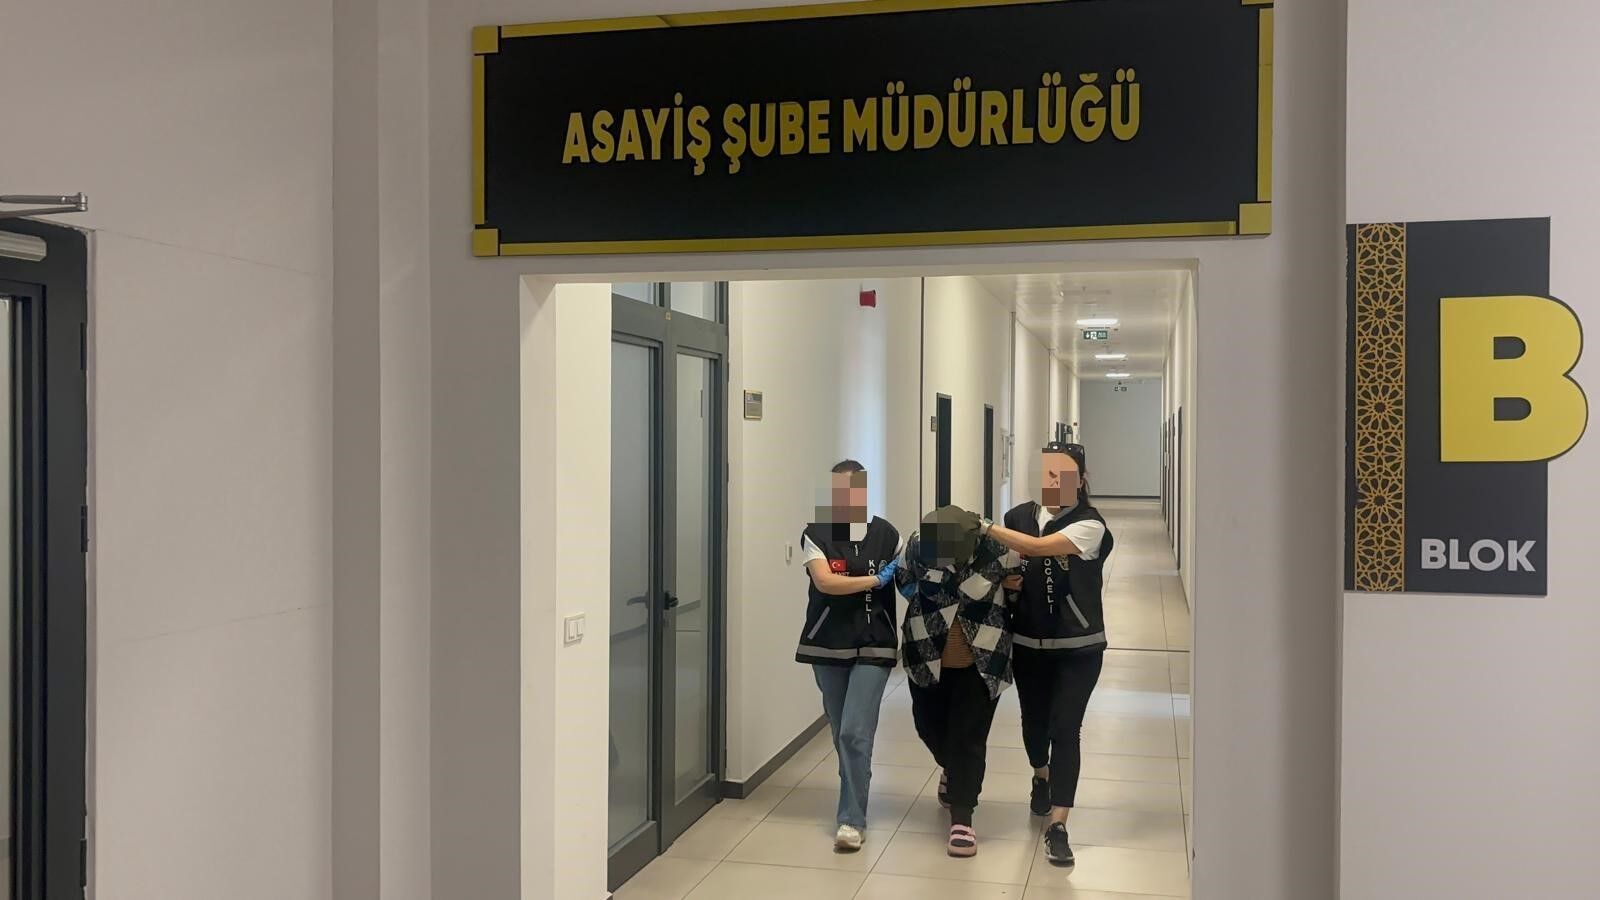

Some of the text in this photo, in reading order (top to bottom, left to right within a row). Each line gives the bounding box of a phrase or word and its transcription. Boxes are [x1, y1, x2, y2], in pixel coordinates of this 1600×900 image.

[562, 68, 1140, 176] ASAYİŞ ŞUBE MÜDÜRLÜĞÜ
[1440, 295, 1588, 463] B
[1420, 538, 1537, 572] BLOK
